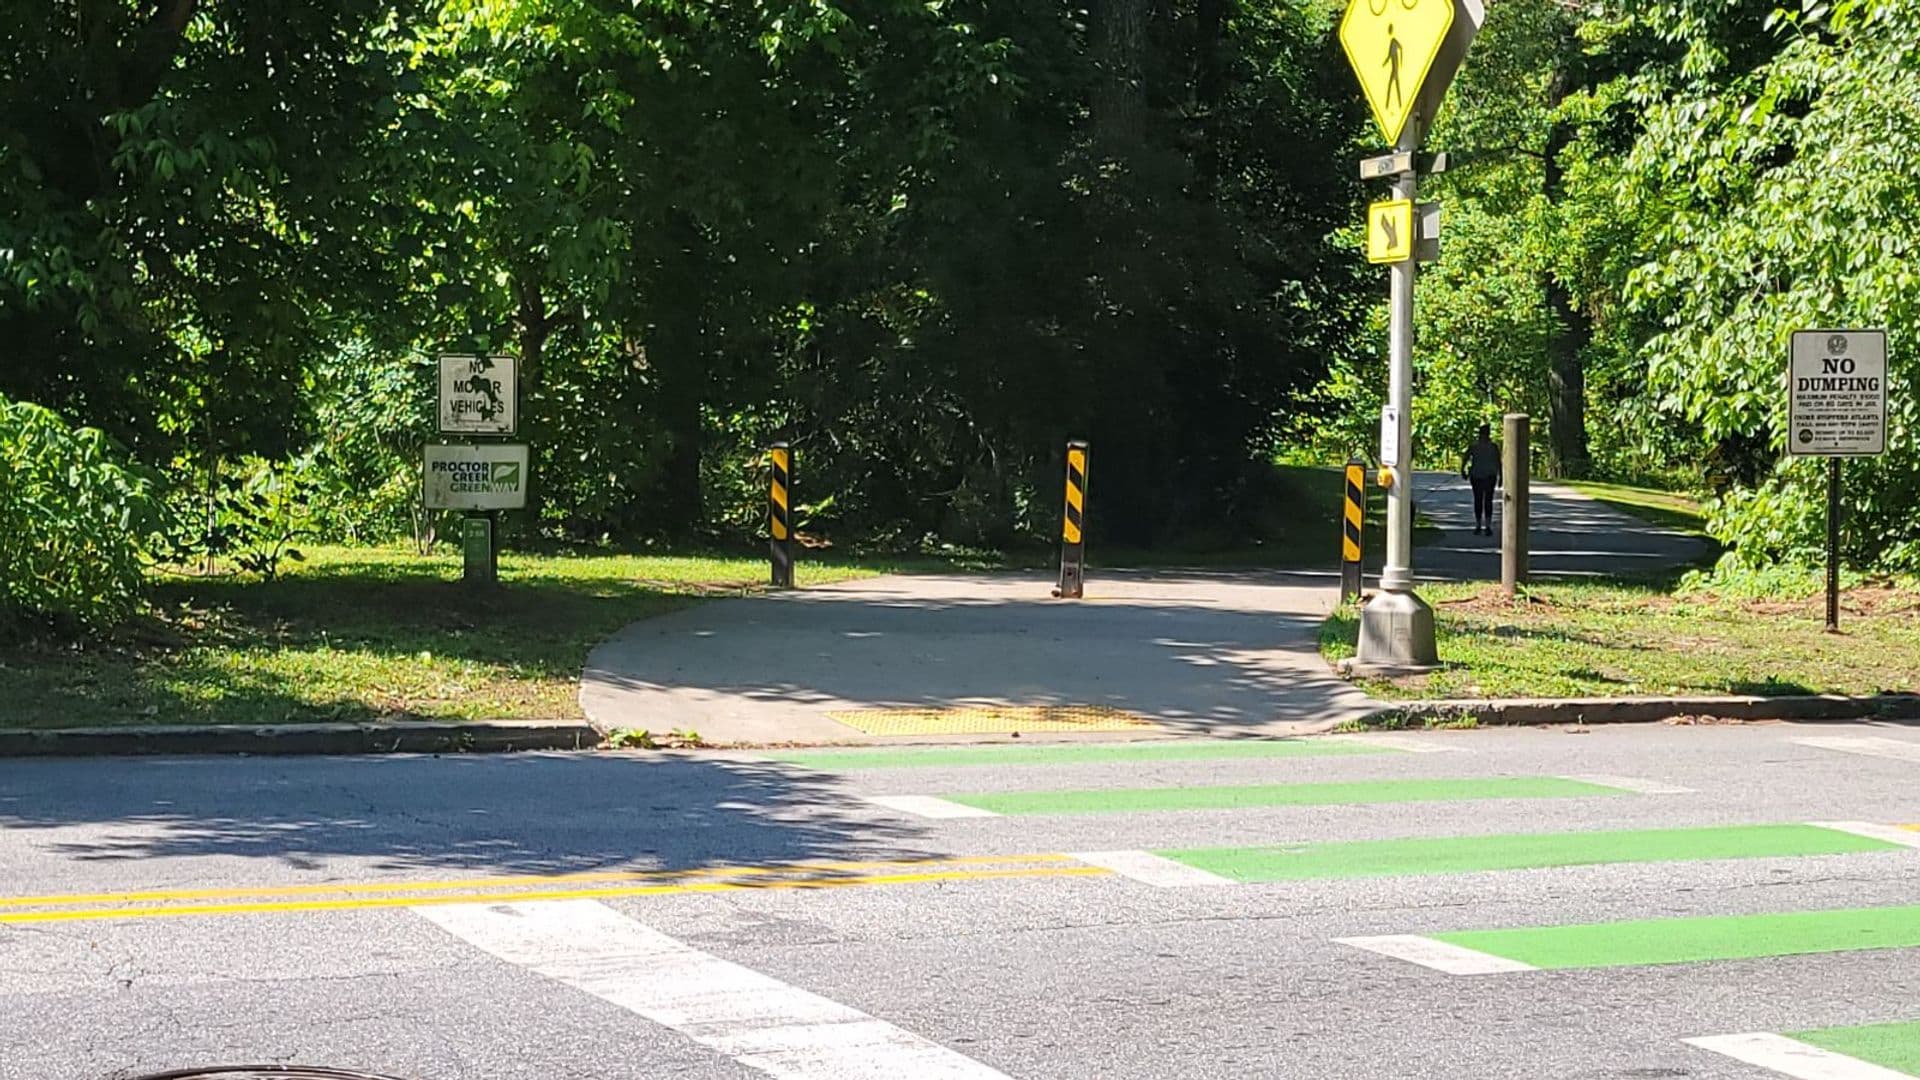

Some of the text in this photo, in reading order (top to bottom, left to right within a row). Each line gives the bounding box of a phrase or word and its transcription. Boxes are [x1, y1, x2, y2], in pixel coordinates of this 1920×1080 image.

[470, 360, 486, 374] NO
[1822, 358, 1856, 374] NO
[454, 380, 502, 394] MOR
[1798, 378, 1879, 392] DUMPING
[450, 400, 504, 414] VEHICLES
[432, 462, 489, 472] PROCTOR
[452, 472, 489, 482] CREEK
[450, 482, 518, 492] GREENWAY
